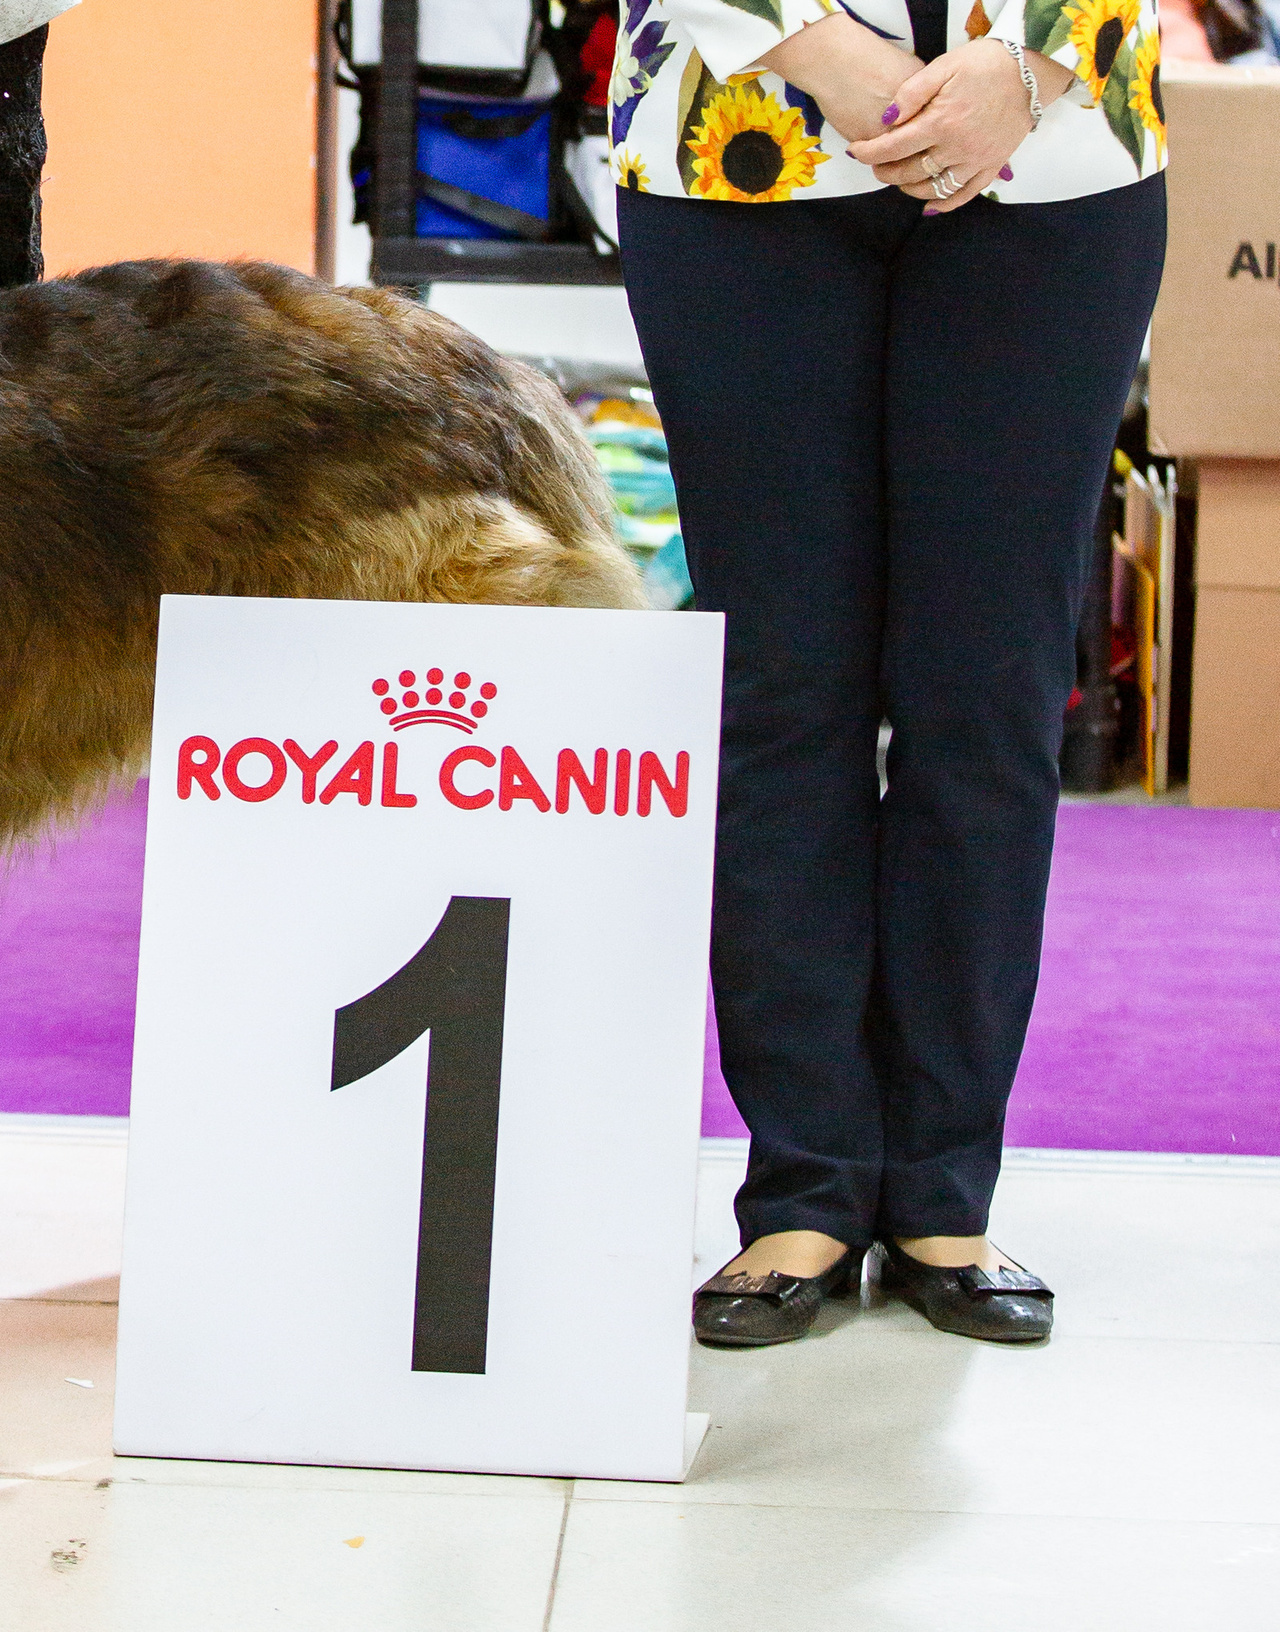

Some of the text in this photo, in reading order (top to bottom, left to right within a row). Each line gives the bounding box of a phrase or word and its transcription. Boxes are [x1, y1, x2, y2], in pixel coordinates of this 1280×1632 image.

[1227, 241, 1280, 287] Al
[176, 734, 690, 818] ROYAL CANIN
[330, 895, 511, 1375] 1
